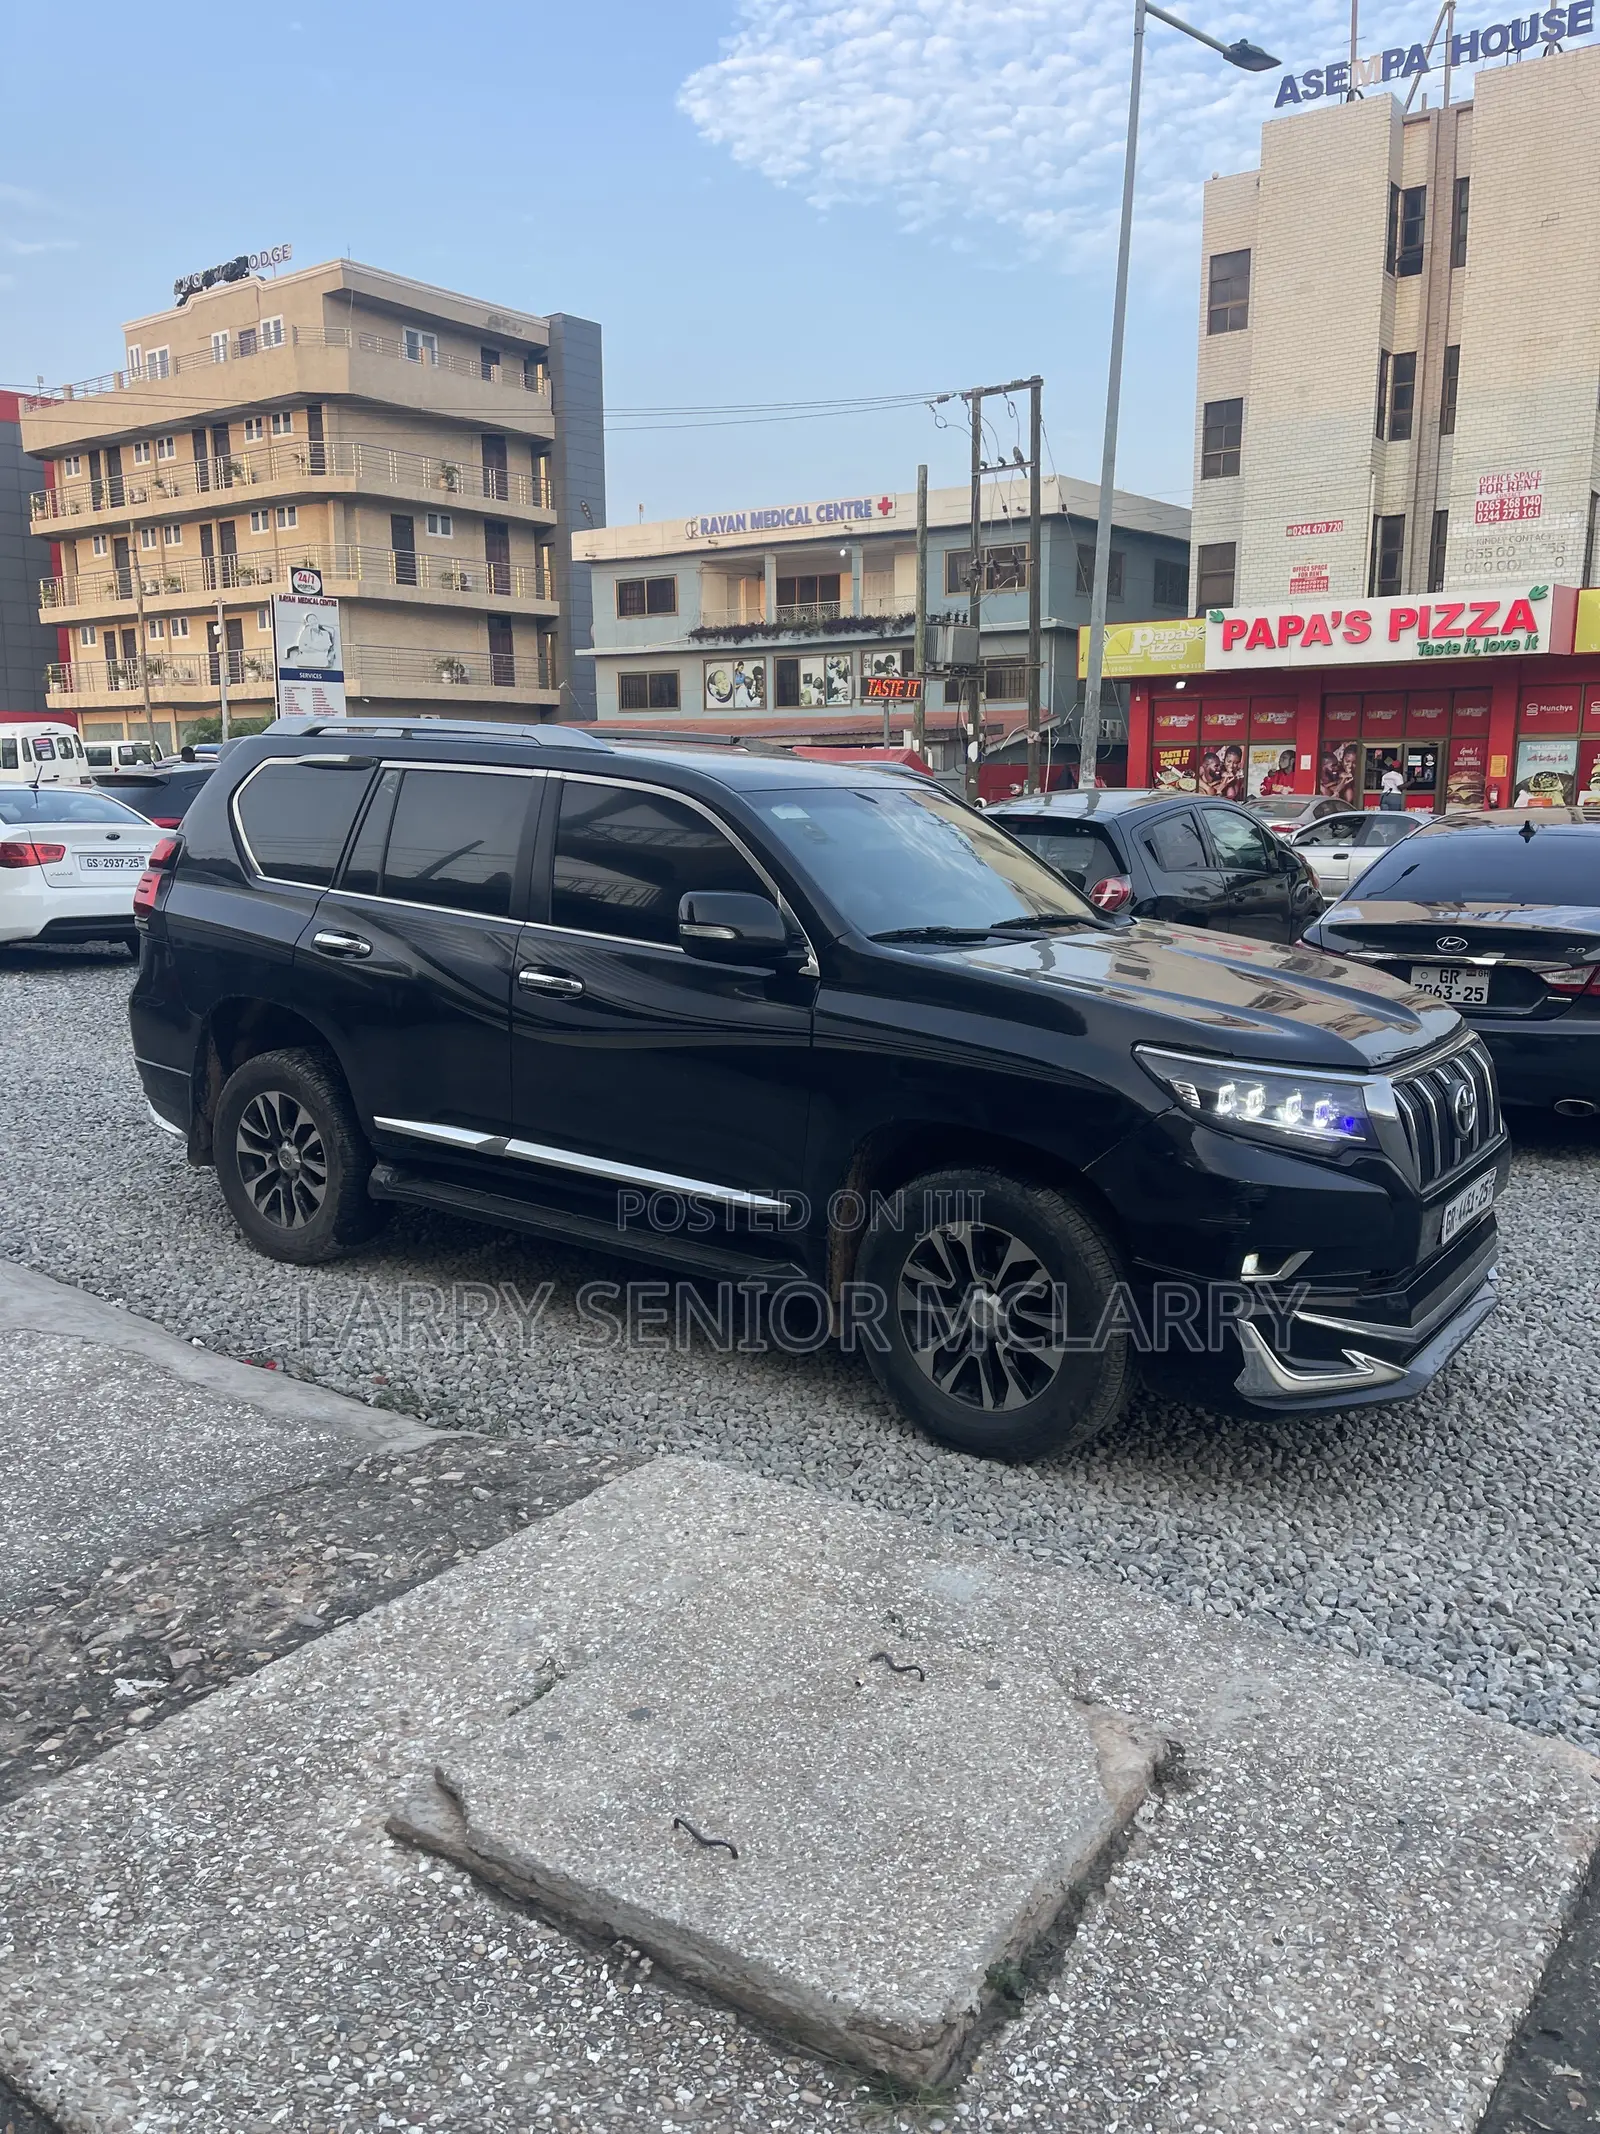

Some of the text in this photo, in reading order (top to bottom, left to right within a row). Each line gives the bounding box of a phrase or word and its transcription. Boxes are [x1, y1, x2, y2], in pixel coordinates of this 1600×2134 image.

[1274, 0, 1594, 108] ASEMPA HOUSE
[248, 243, 292, 271] ODGE
[1479, 469, 1542, 485] OFFICE SPACE
[1479, 479, 1540, 495] FOR RENT
[1477, 496, 1541, 511] 0265 268 040
[700, 512, 747, 536] RAYAN
[750, 506, 813, 530] MEDICAL
[815, 498, 873, 523] CENTRE
[1477, 506, 1540, 522] 0244 278 161
[1293, 521, 1342, 536] 0244 470 720
[297, 571, 315, 585] 24/7
[297, 596, 319, 606] MEDICAL
[1222, 599, 1538, 651] PAPA'S PIZZA
[1417, 635, 1538, 656] Taste it, love it
[867, 678, 921, 698] TASTE IT
[1539, 704, 1573, 713] Munchys
[1159, 749, 1190, 759] TASTE IT
[1160, 757, 1189, 767] LOVE IT
[86, 858, 140, 868] GS 2937-25
[1439, 969, 1489, 984] GR GH
